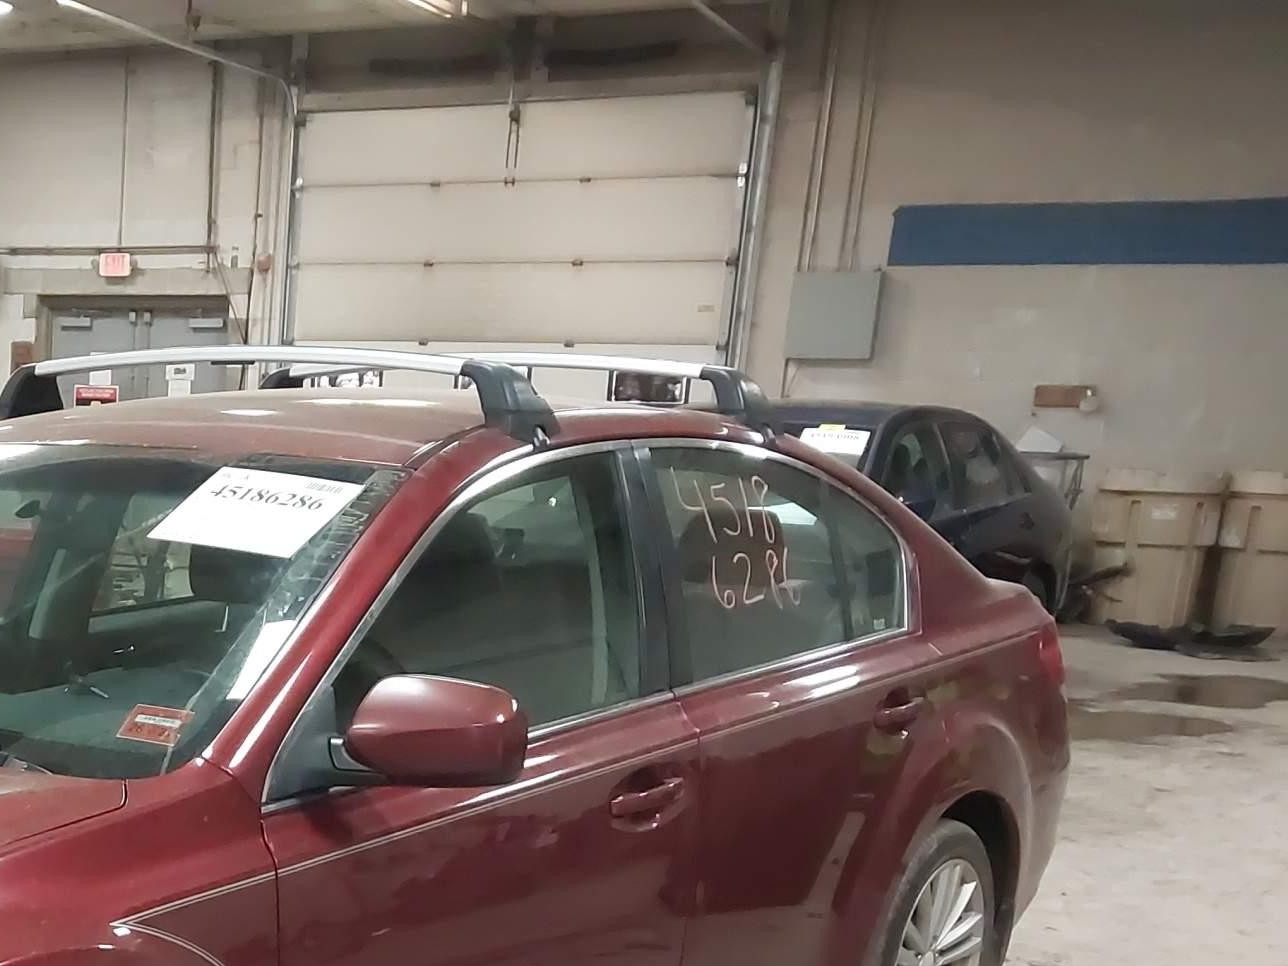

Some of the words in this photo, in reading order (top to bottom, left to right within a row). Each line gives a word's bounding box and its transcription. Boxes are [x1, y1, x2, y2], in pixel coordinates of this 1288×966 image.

[211, 484, 324, 511] 45186286
[670, 466, 775, 544] 4518
[712, 547, 801, 610] 6286
